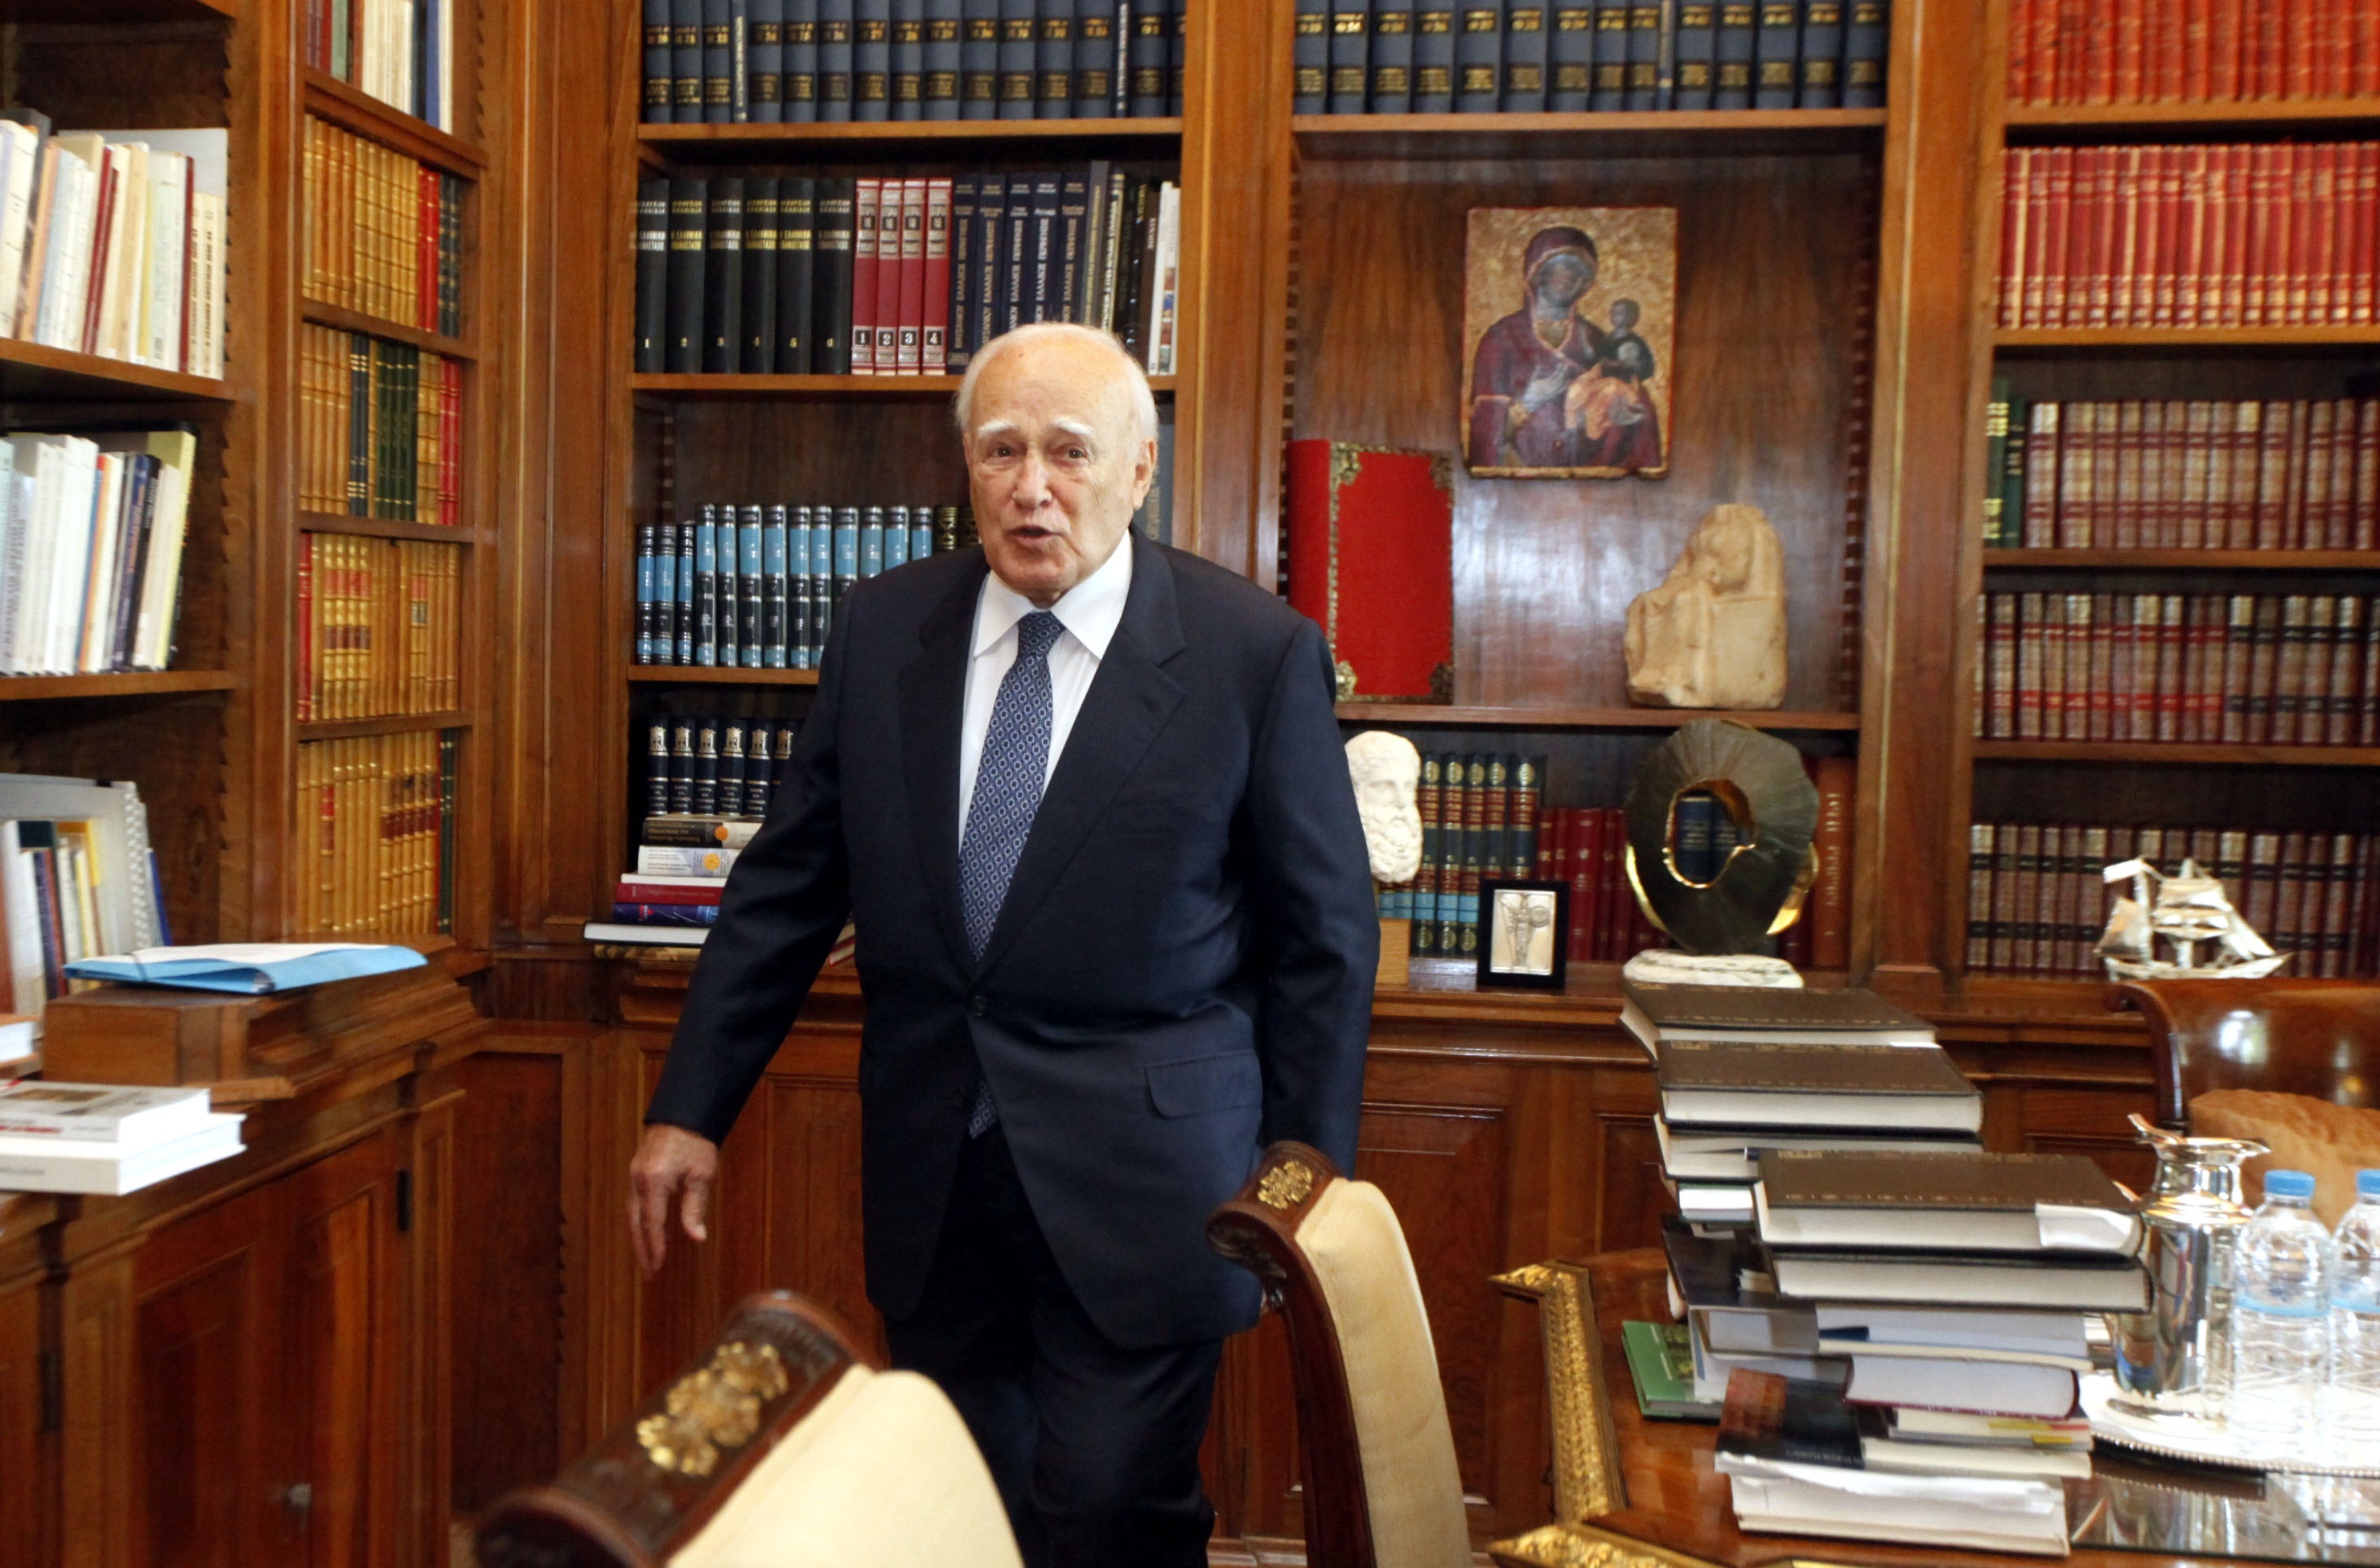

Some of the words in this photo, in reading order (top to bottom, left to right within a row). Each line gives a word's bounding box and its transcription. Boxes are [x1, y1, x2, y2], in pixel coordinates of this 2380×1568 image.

[680, 336, 689, 348] 2
[859, 332, 867, 344] 1
[883, 333, 891, 345] 2
[904, 332, 912, 344] 3
[929, 332, 938, 344] 4
